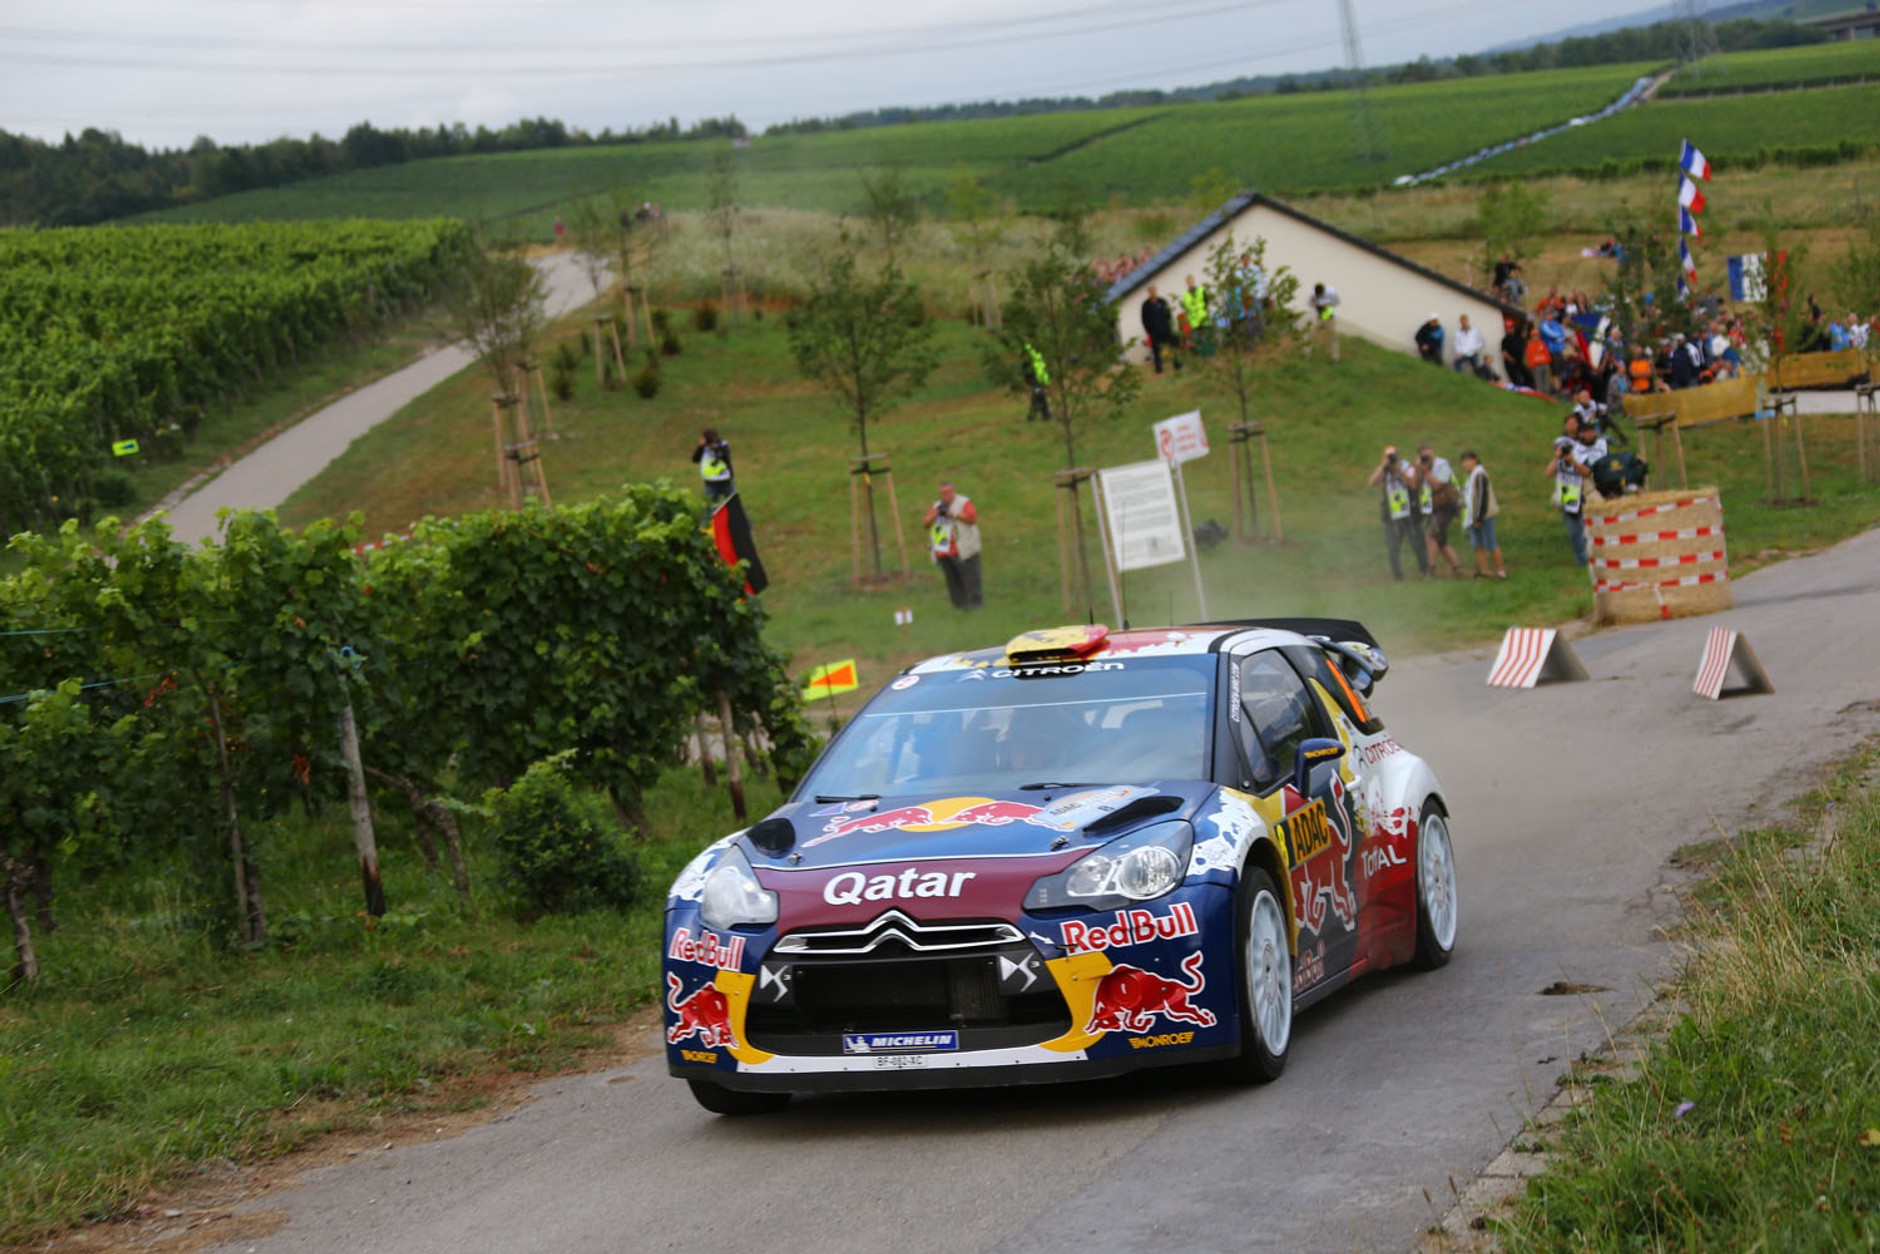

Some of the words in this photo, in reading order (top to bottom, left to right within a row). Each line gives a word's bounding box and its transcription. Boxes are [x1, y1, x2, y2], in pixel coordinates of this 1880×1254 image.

[1292, 802, 1329, 861] ADAC
[823, 867, 977, 906] Qatar
[871, 1035, 952, 1047] MICHELIN
[1130, 1031, 1195, 1049] MONROE
